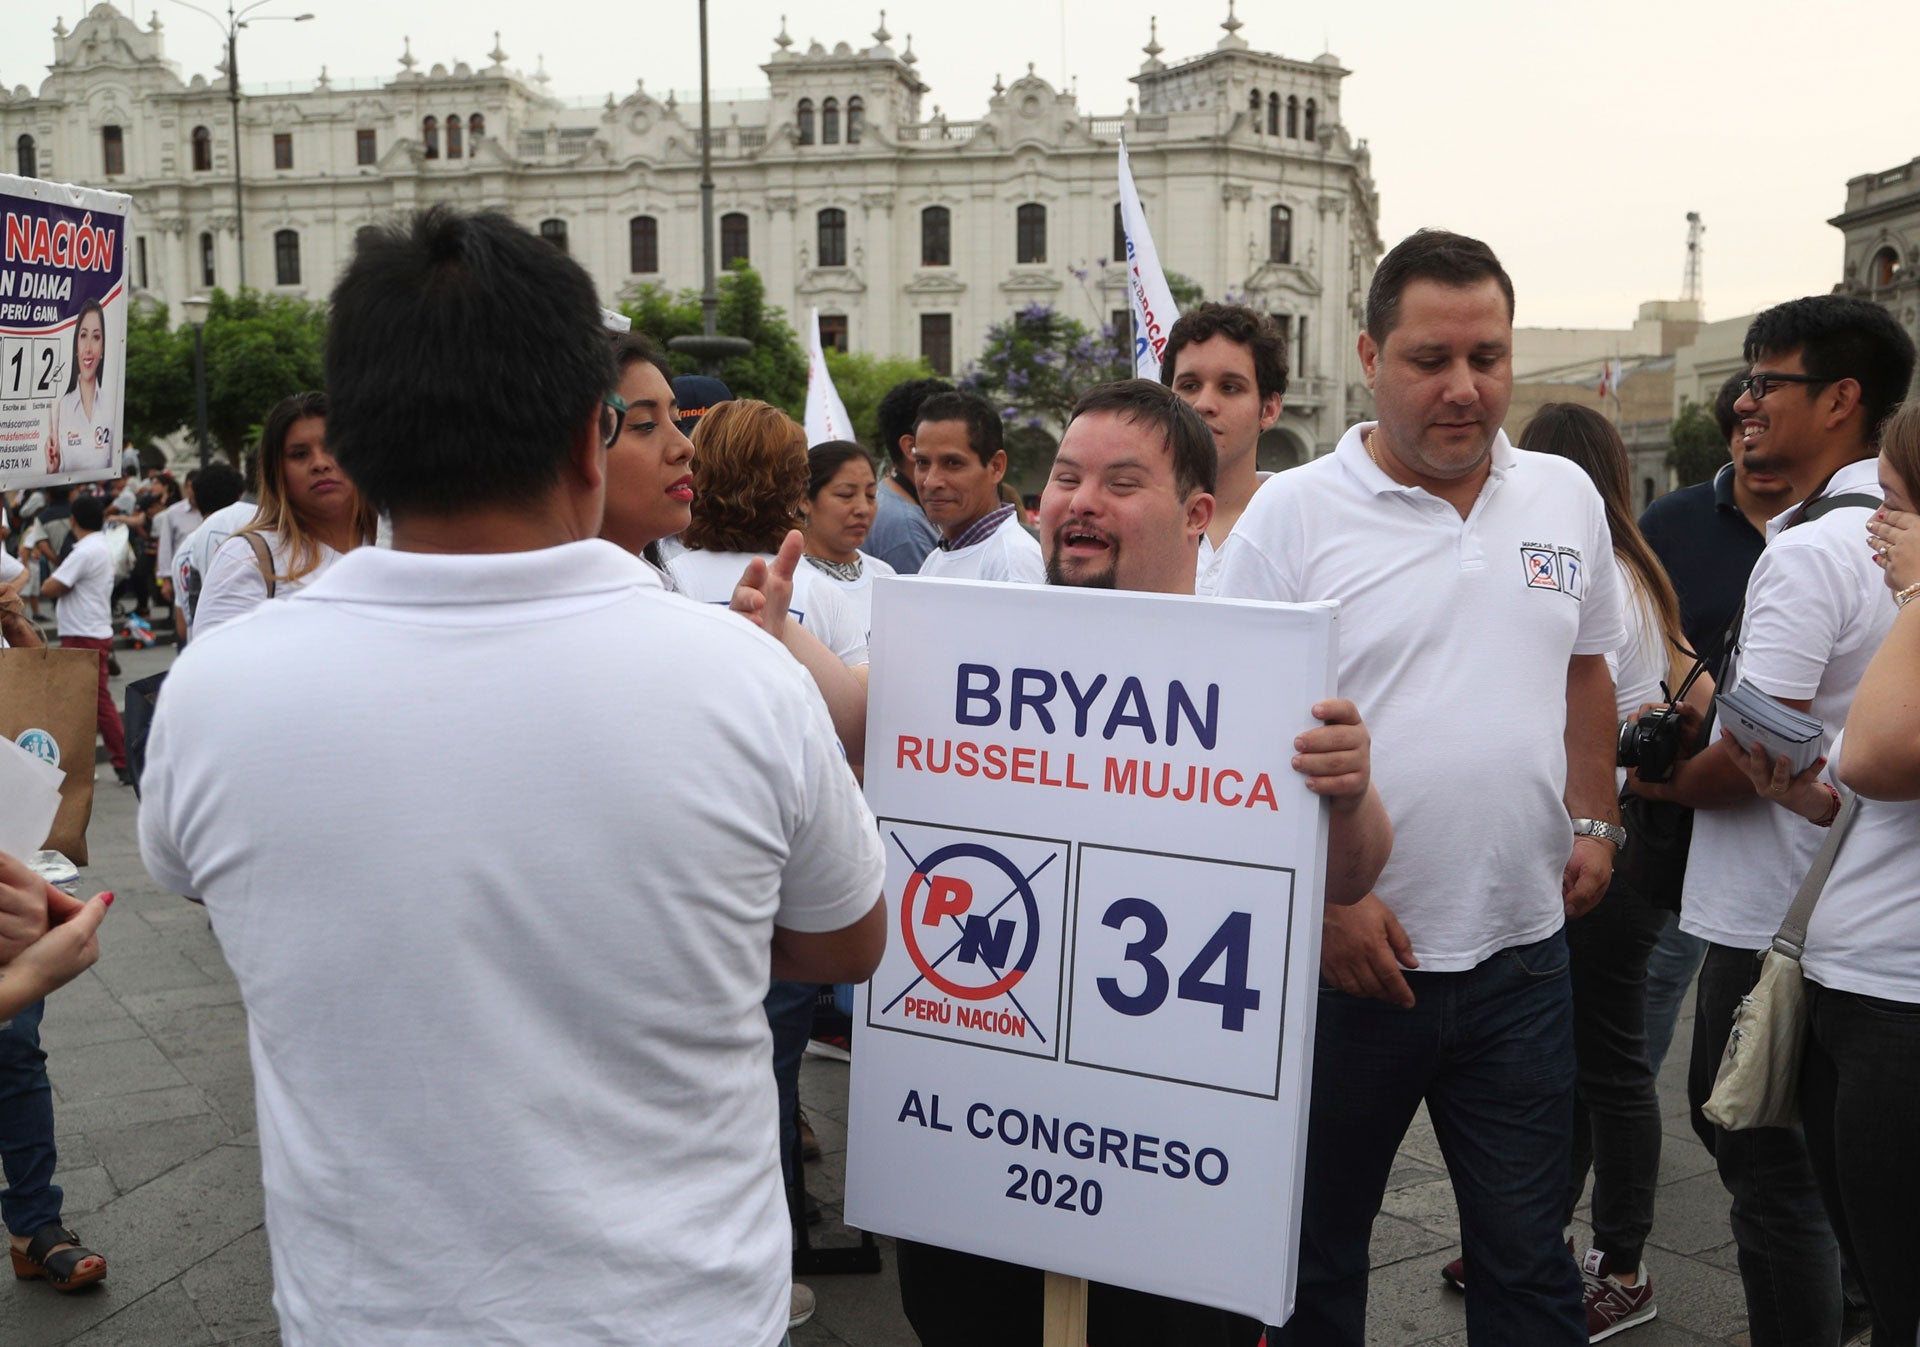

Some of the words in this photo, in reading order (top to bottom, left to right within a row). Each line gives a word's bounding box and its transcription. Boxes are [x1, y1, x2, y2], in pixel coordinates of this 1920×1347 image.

[5, 211, 115, 273] NACIÓN
[0, 269, 15, 297] N
[19, 271, 72, 301] DIANA
[0, 301, 31, 321] PERÚ
[33, 305, 58, 322] GANA
[11, 346, 23, 392] 1
[37, 347, 54, 391] 2
[0, 458, 19, 470] ASTA
[21, 457, 32, 468] YA!
[1568, 561, 1577, 591] 7
[955, 663, 1220, 751] BRYAN
[896, 734, 1089, 790] RUSSELL
[1103, 756, 1280, 812] MUJICA
[1096, 897, 1261, 1033] 34
[904, 996, 952, 1024] PERÚ
[956, 1007, 1026, 1038] NACIÓN
[898, 1089, 953, 1133] AL
[966, 1102, 1229, 1187] CONGRESO
[1005, 1163, 1103, 1217] 2020
